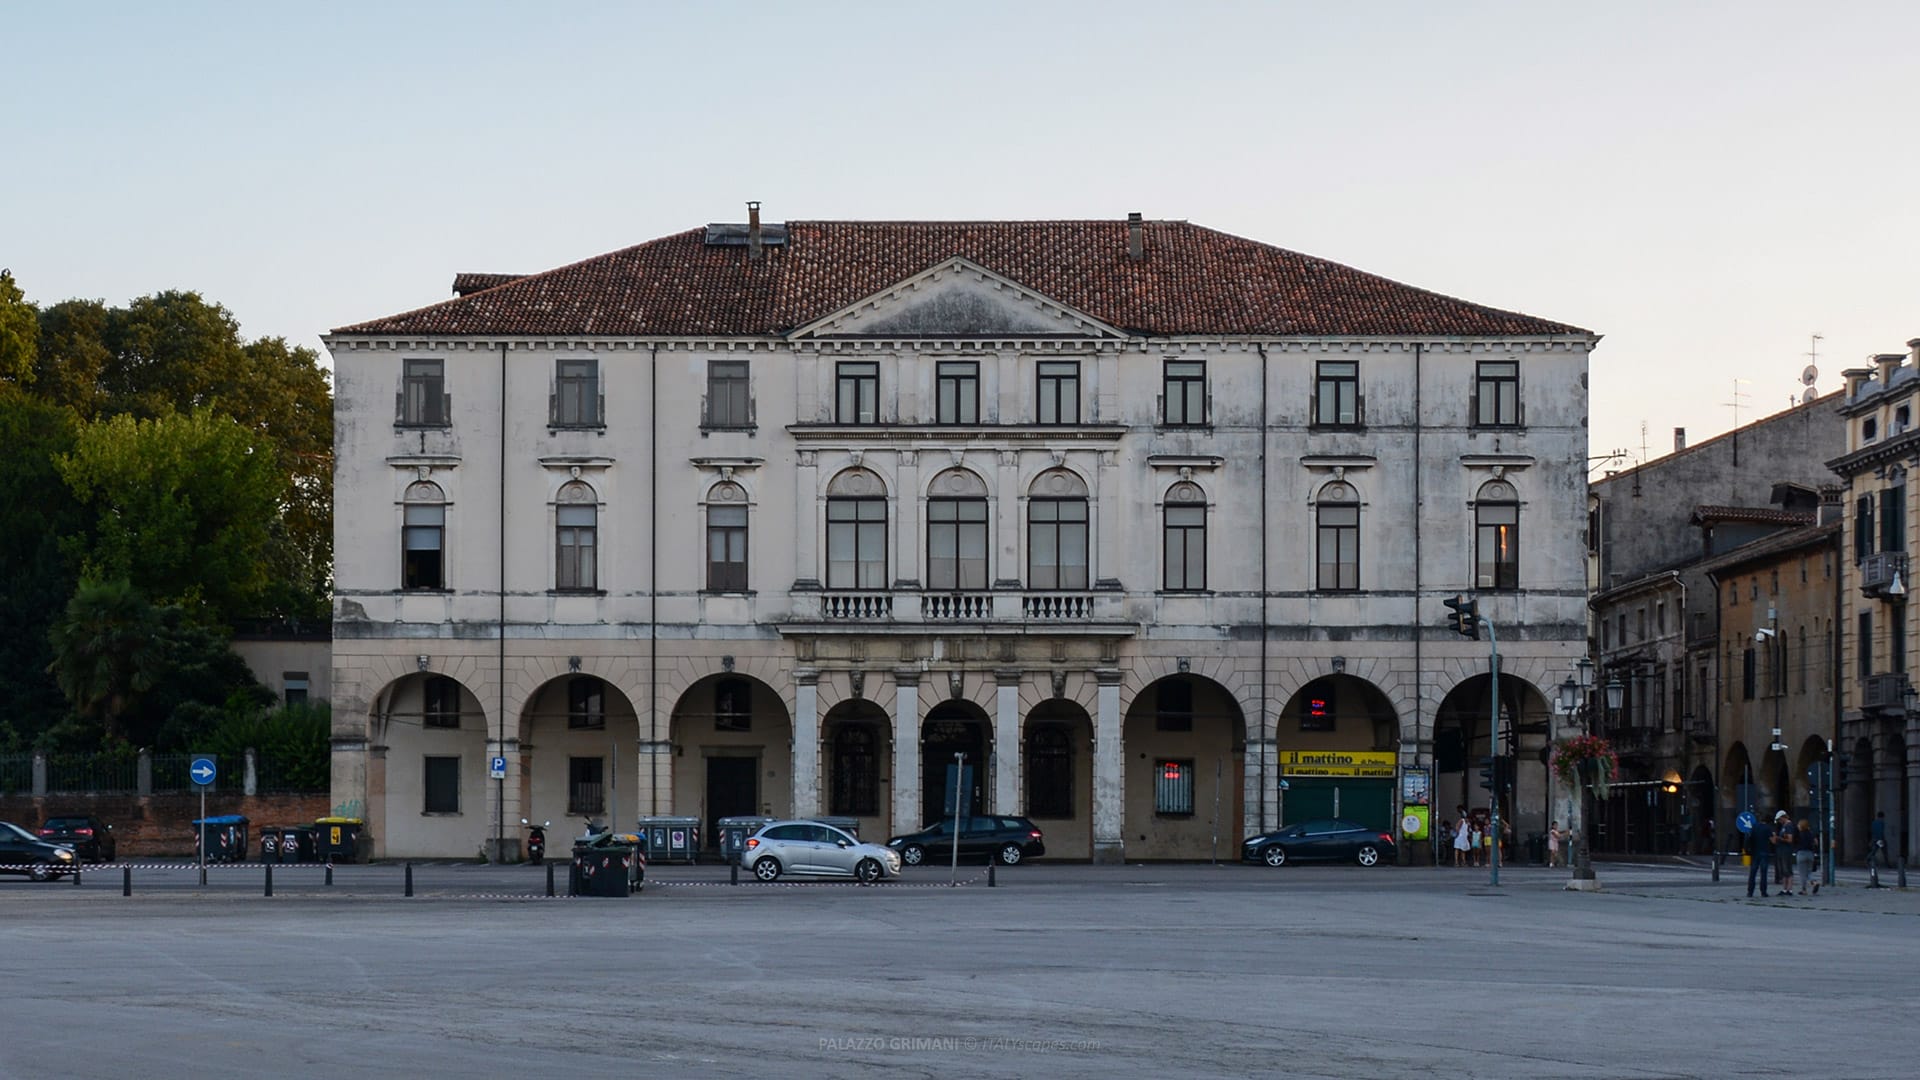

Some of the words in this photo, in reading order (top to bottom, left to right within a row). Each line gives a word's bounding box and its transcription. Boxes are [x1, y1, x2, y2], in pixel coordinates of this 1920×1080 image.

[1290, 752, 1298, 764] il
[1302, 753, 1353, 764] mattino
[494, 758, 503, 770] P
[1288, 767, 1294, 775] il
[1296, 767, 1329, 775] mattino
[1354, 767, 1360, 775] il
